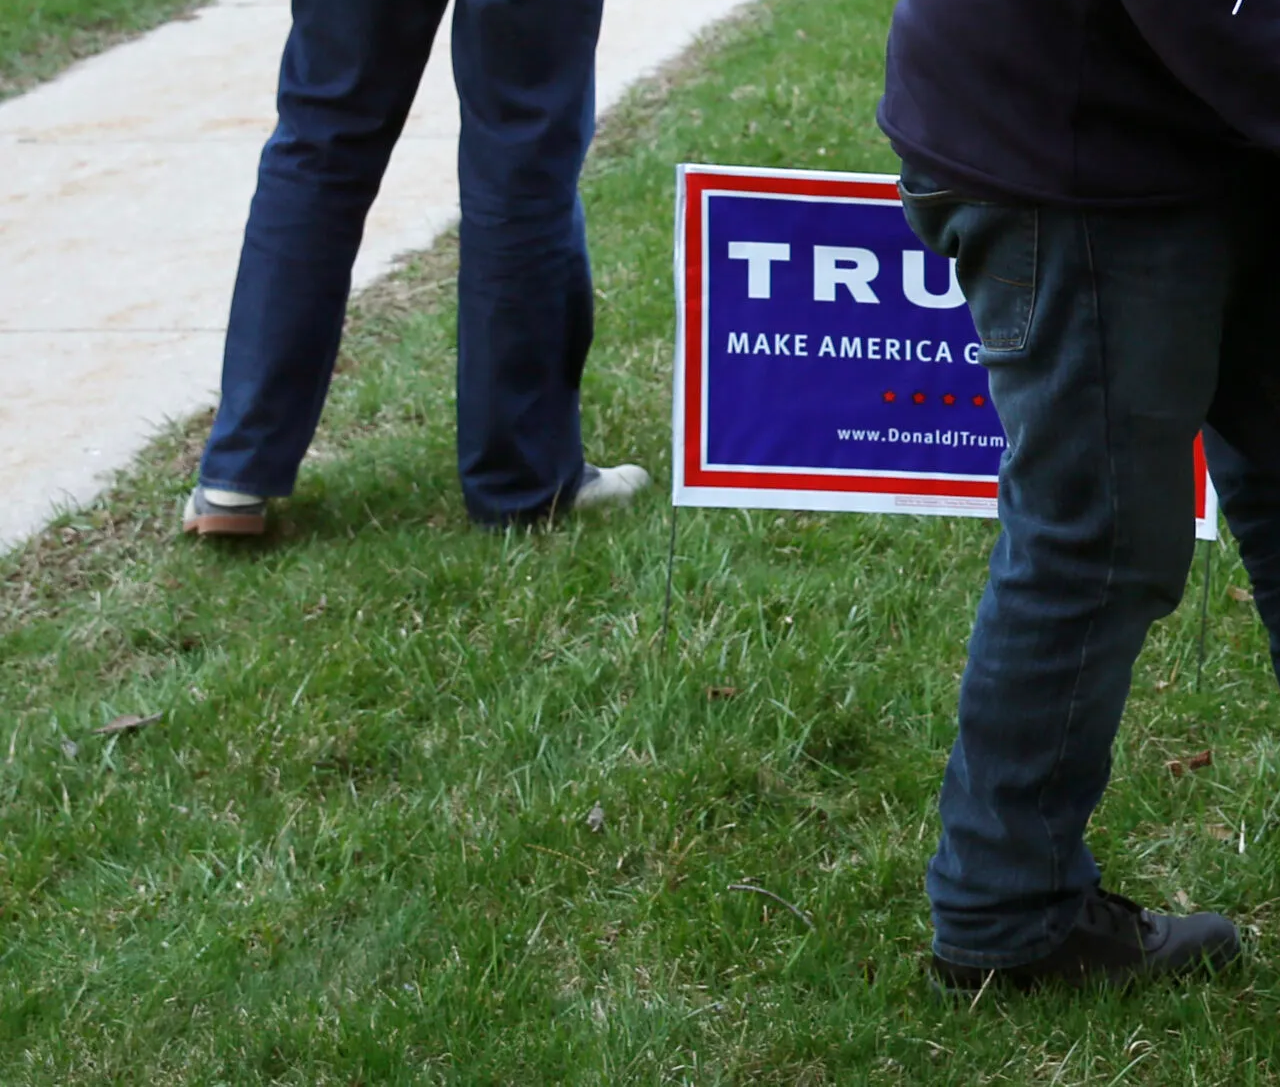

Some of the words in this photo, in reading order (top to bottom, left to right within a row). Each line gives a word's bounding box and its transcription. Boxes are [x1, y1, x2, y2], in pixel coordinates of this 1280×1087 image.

[728, 241, 970, 309] TRU
[726, 331, 809, 357] MAKE
[817, 335, 953, 363] AMERICA
[837, 427, 1008, 449] www.DonaldJTrum
